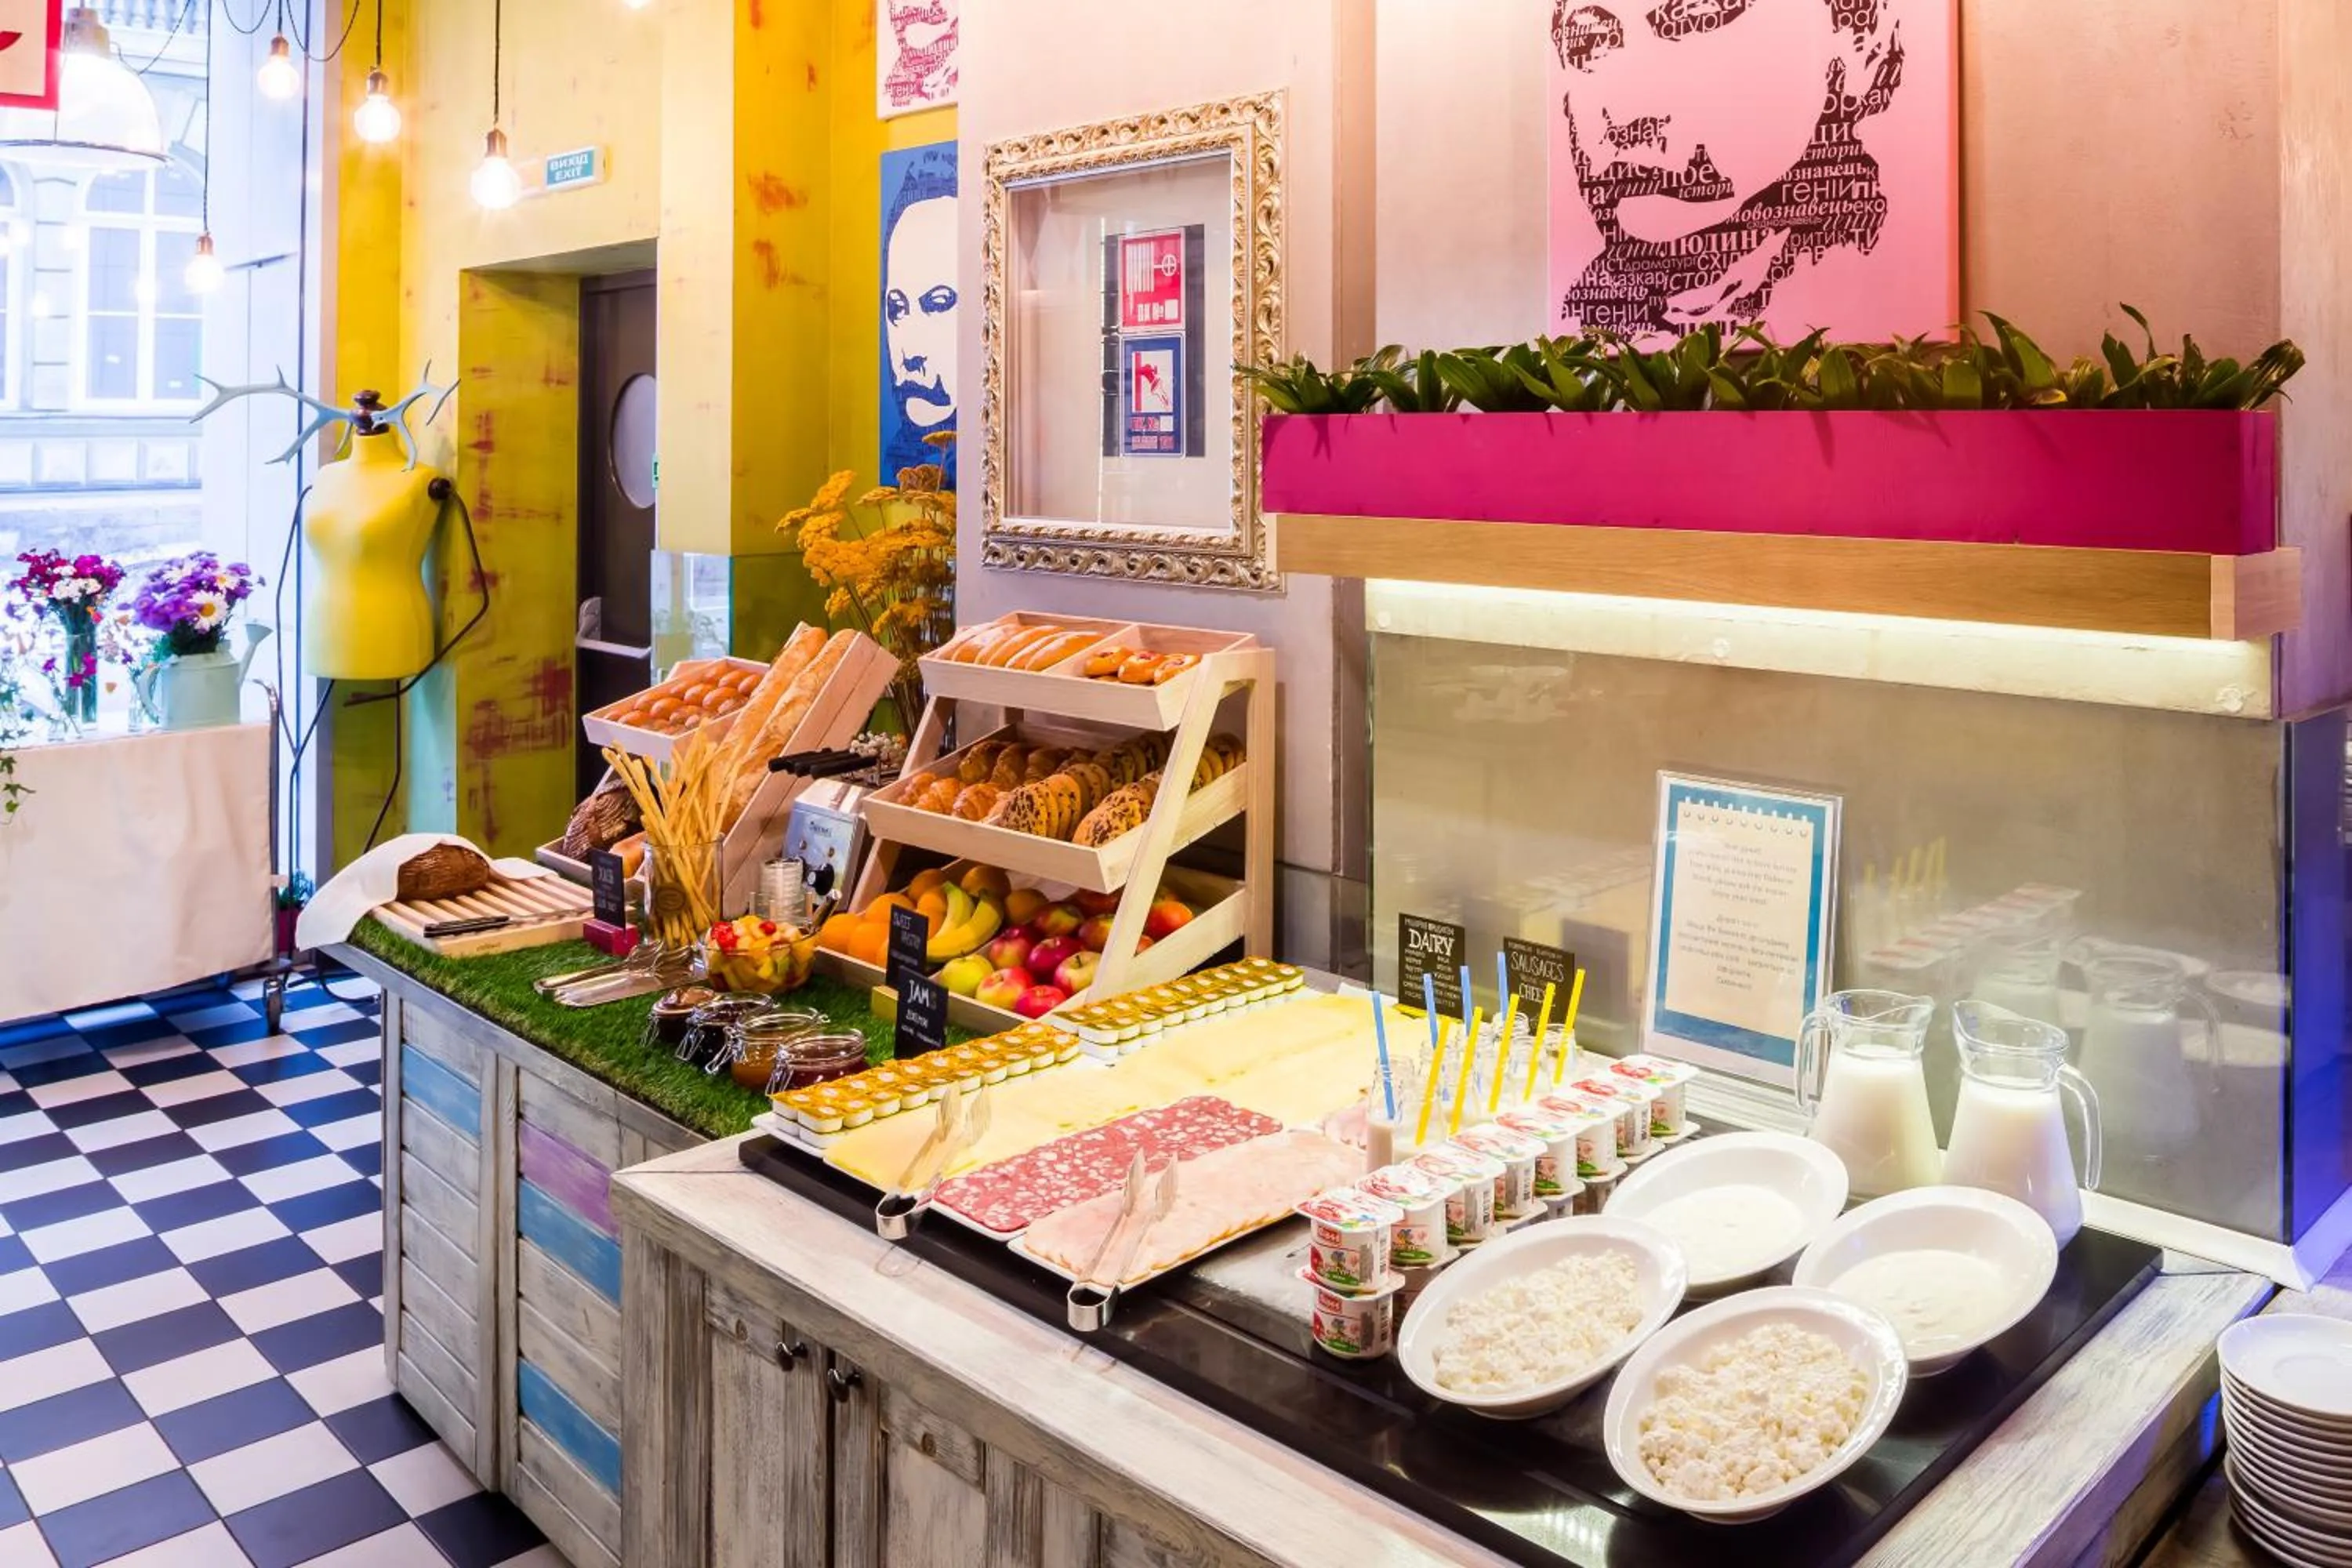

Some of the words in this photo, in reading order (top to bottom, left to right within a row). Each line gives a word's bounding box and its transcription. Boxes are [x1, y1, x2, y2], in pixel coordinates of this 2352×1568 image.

[555, 166, 583, 182] EXIT
[1659, 225, 1773, 258] людин
[1408, 927, 1456, 956] DAIRY
[1510, 951, 1565, 983] SAUSAGES
[1519, 982, 1556, 1008] CHEE
